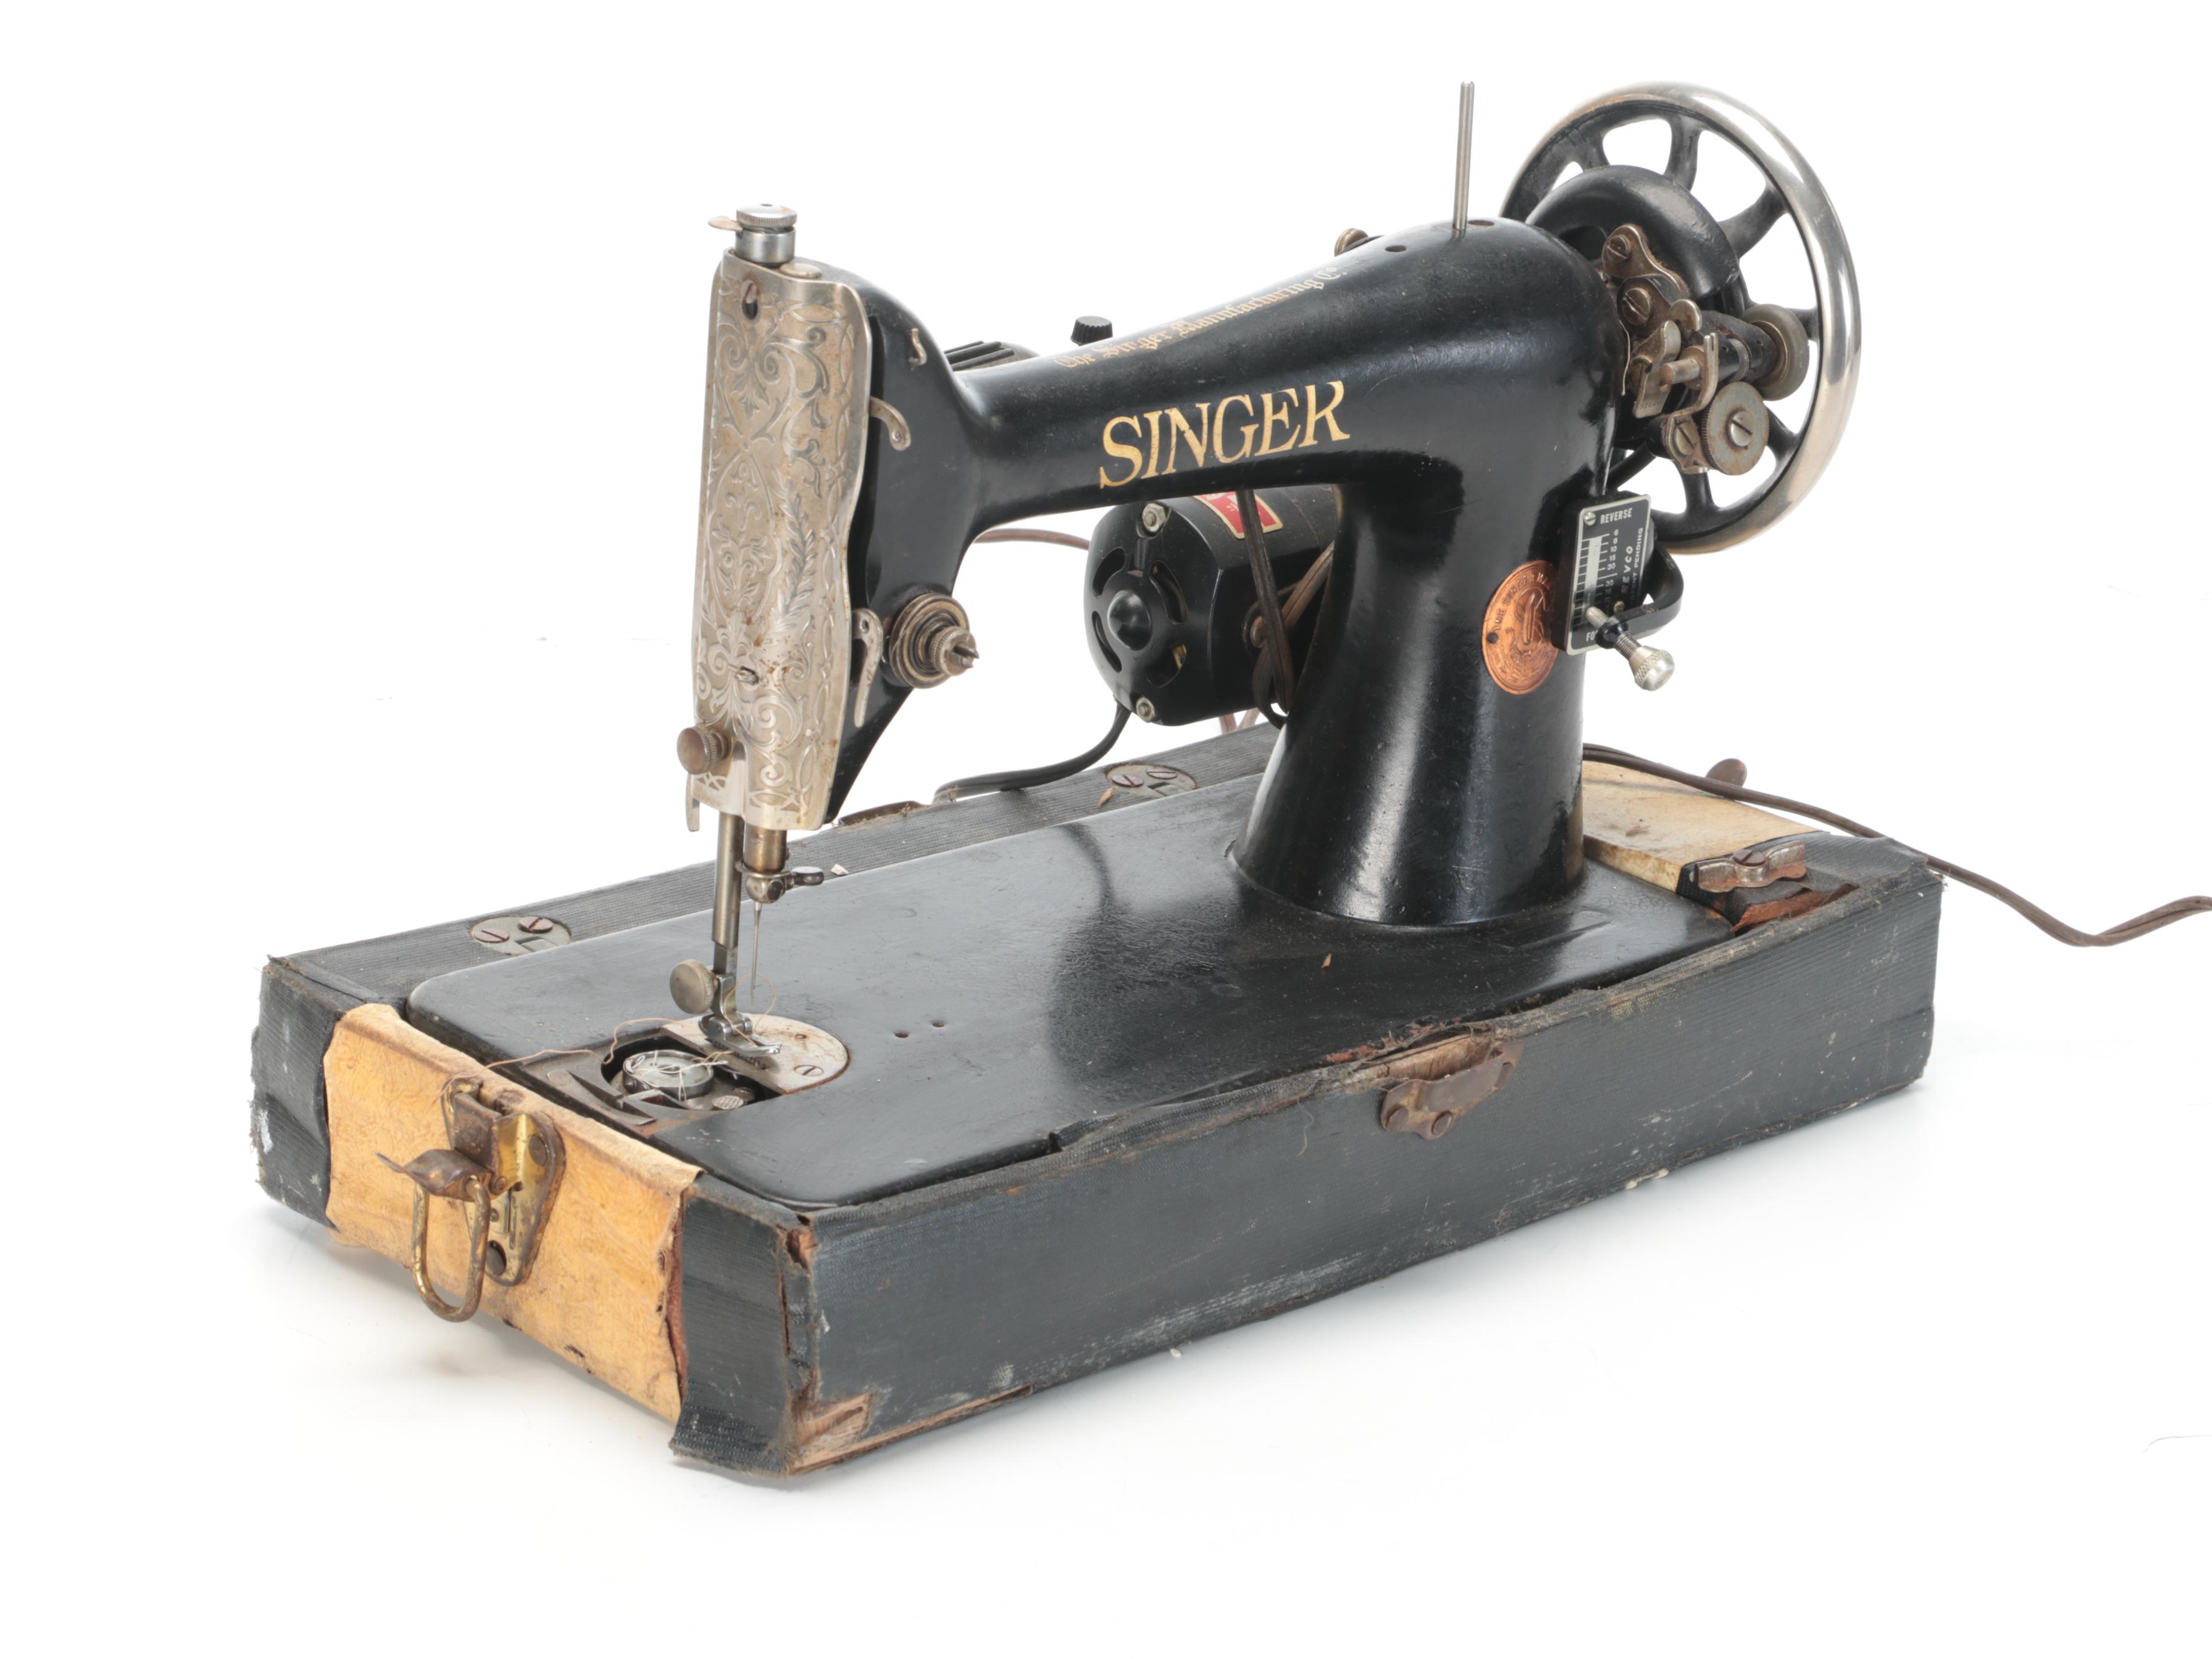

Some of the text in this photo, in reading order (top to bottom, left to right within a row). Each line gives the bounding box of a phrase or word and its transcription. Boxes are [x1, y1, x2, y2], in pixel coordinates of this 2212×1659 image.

[1053, 354, 1096, 367] The
[1090, 331, 1173, 358] Singer
[1170, 279, 1325, 338] Manufacturing
[1099, 380, 1351, 489] SINGER
[1600, 508, 1633, 524] REVERSE
[1607, 562, 1616, 570] 30
[1620, 546, 1633, 593] REVCO
[1633, 527, 1643, 568] PENDING
